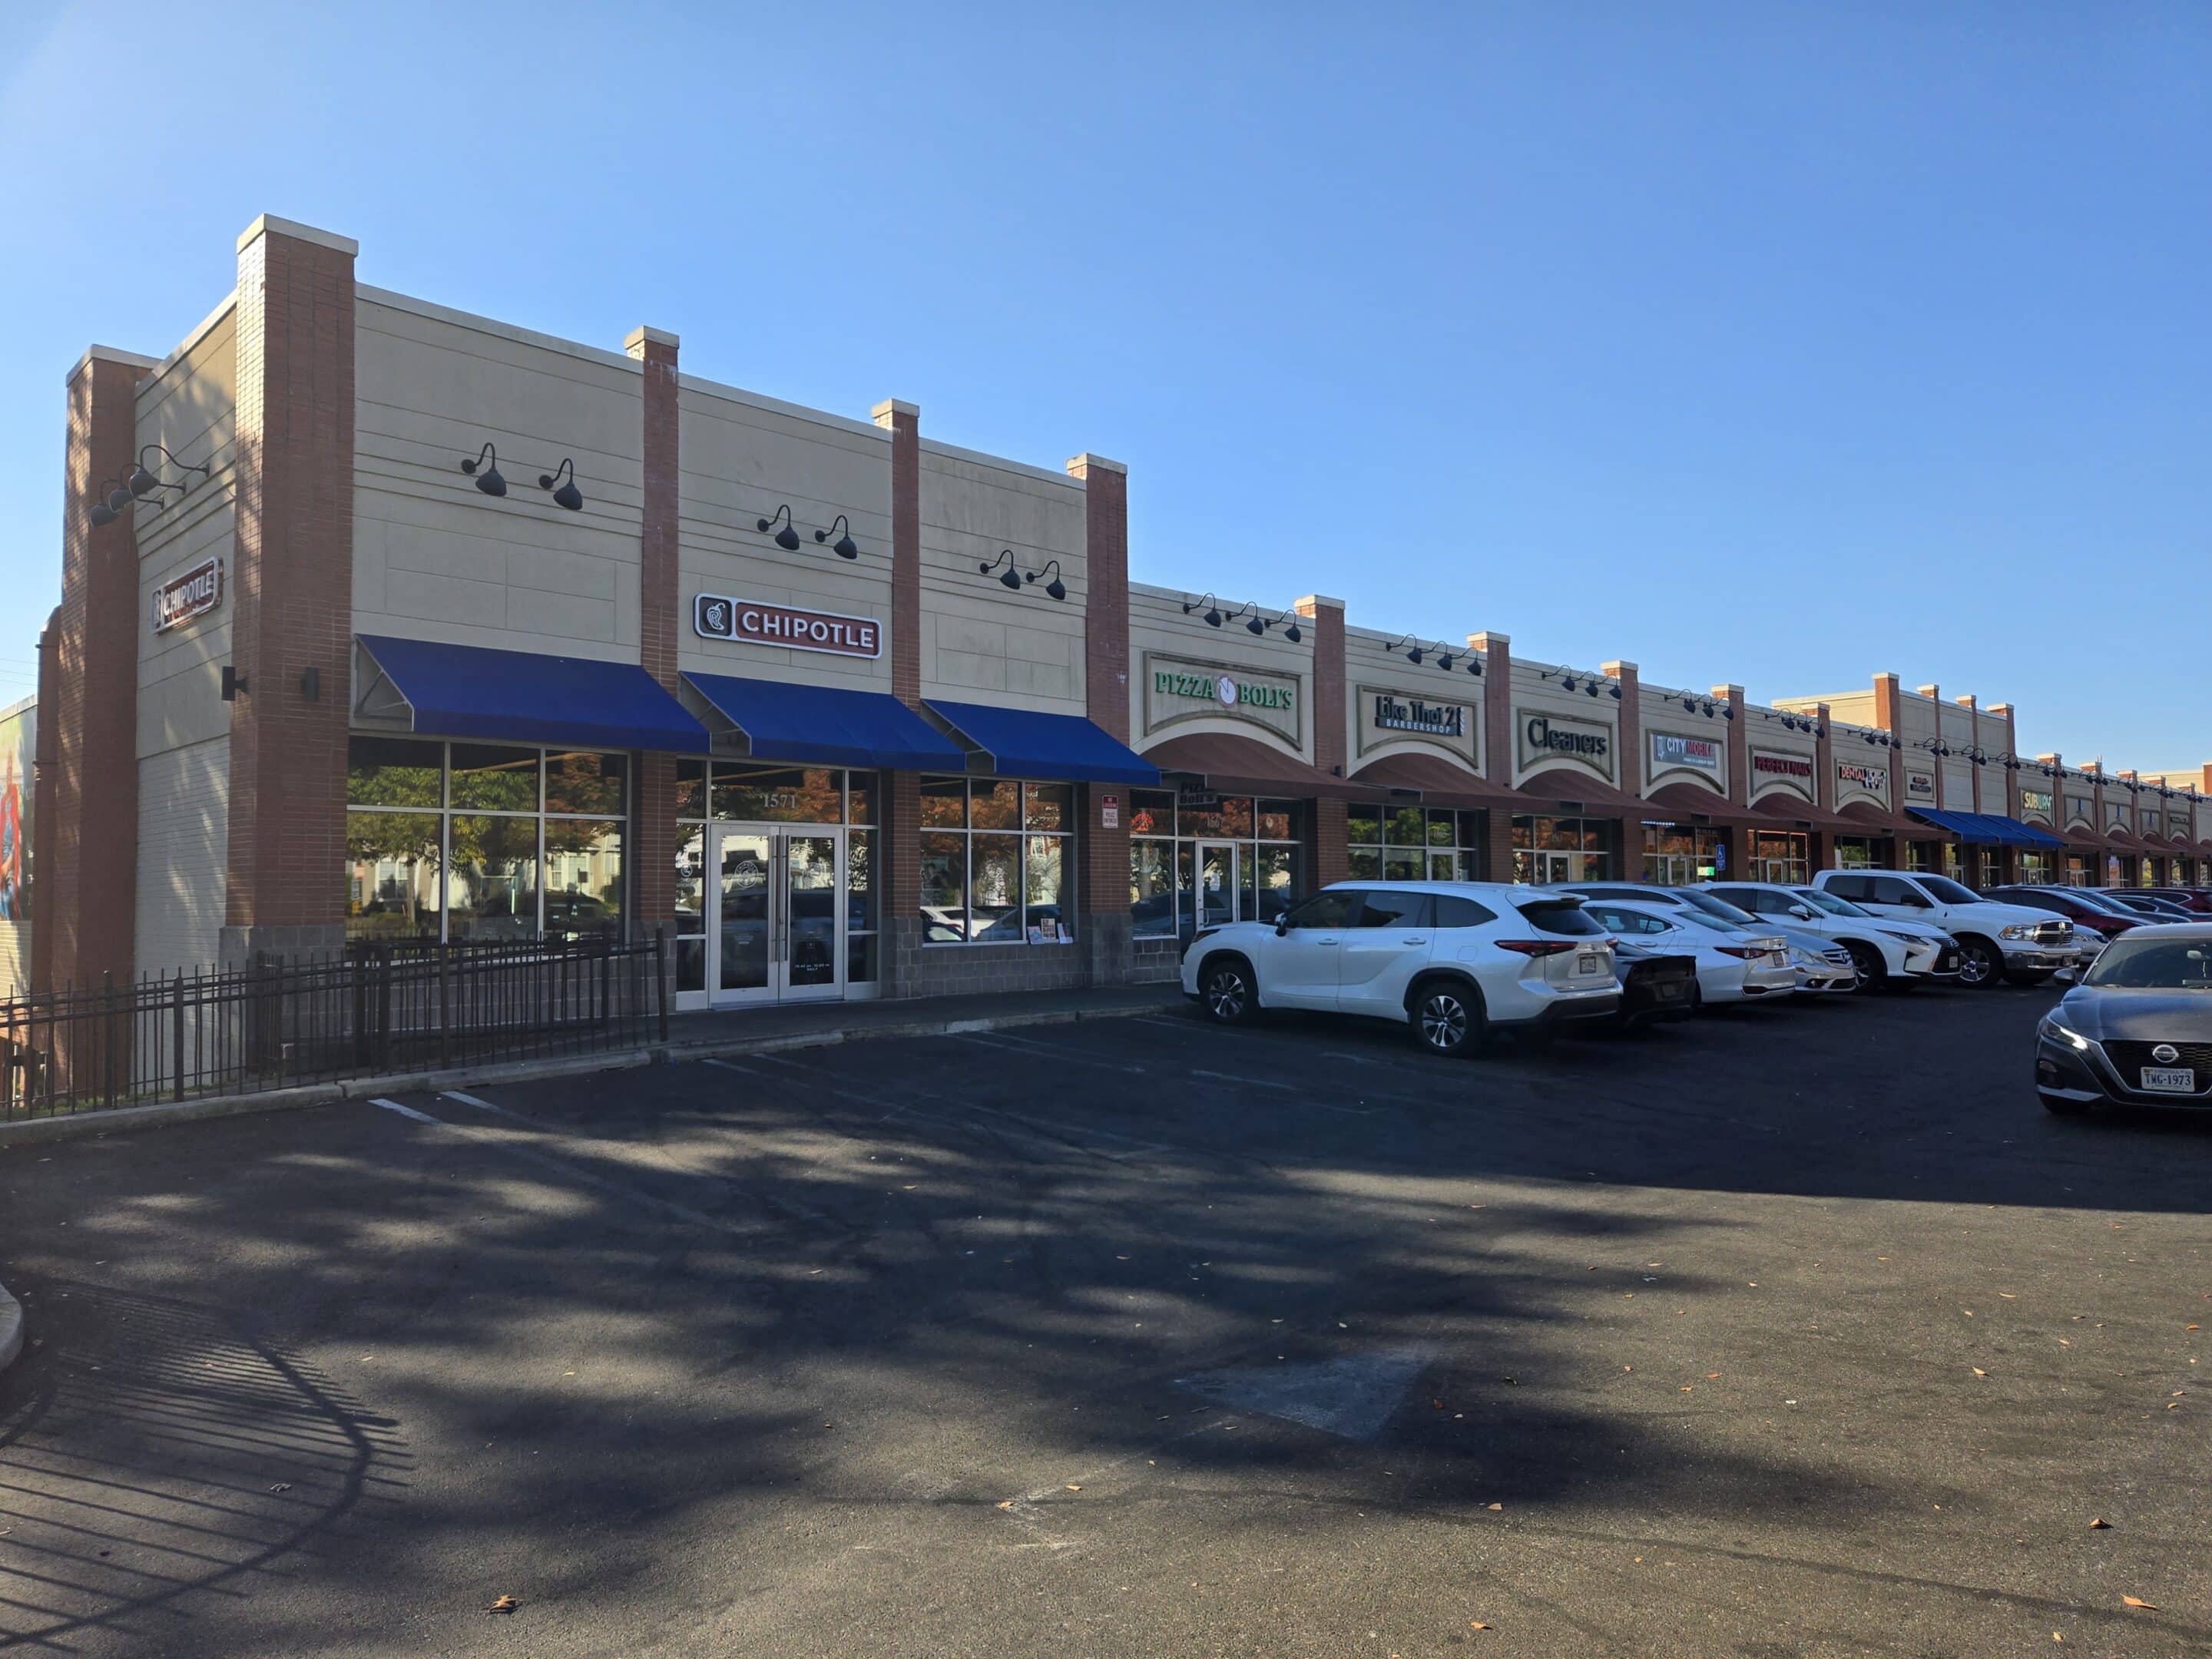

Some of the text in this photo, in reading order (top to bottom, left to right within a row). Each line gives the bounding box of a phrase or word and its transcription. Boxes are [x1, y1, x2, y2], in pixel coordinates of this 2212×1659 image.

[164, 569, 214, 616] CHIPOTLE
[742, 611, 874, 648] CHIPOTLE
[1155, 671, 1293, 710] PIZZA BOLI'S
[1376, 696, 1408, 720] Like
[1409, 700, 1443, 724] That
[1386, 719, 1451, 733] BARBERSHOP
[1528, 718, 1607, 755] Cleaners
[1667, 737, 1686, 754] CITY
[1757, 757, 1812, 777] PERFECT NAILS
[1840, 767, 1866, 781] DENTAL
[763, 794, 796, 808] 1571
[2023, 792, 2052, 811] SUBWAY
